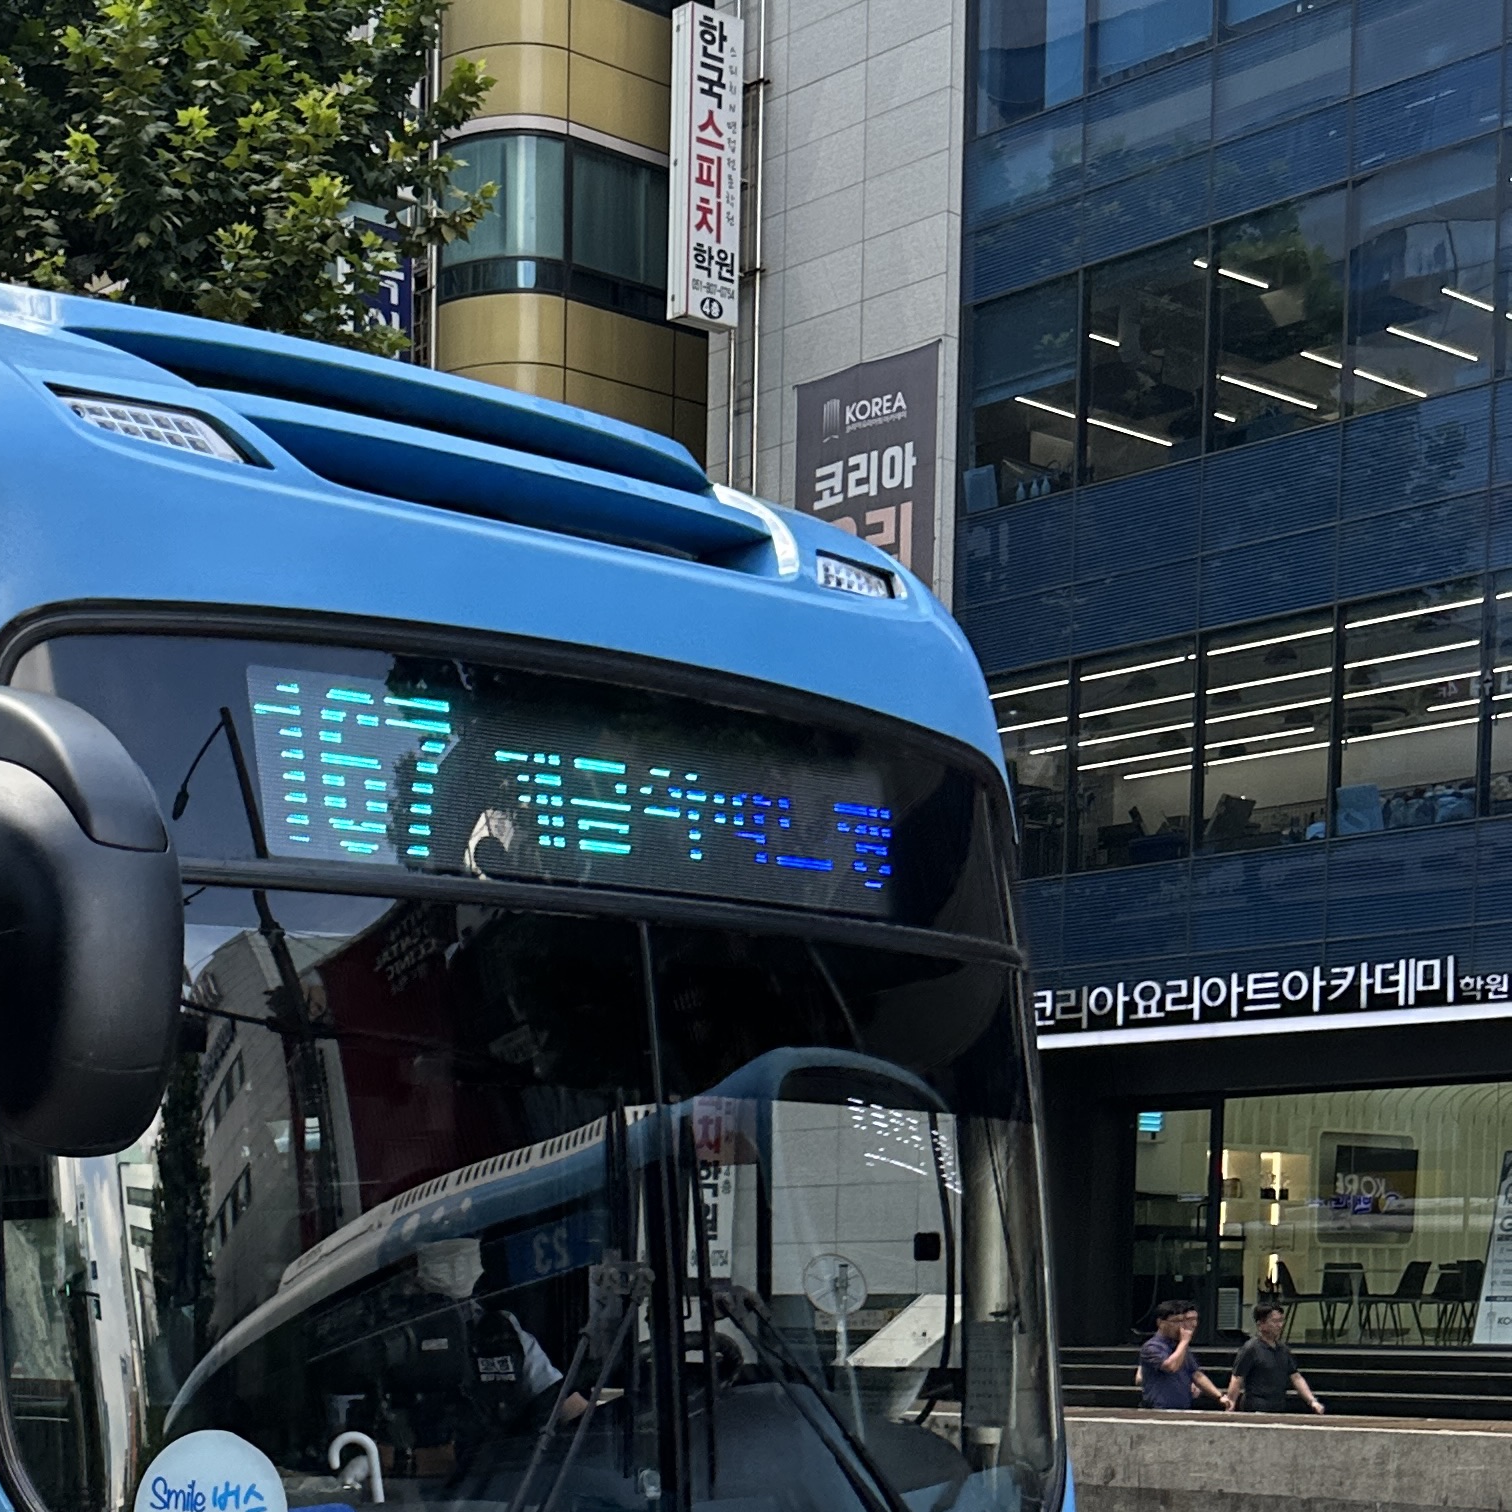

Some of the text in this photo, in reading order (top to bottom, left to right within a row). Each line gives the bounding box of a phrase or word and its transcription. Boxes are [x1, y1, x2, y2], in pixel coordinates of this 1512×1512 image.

[692, 242, 735, 284] 학원
[845, 391, 907, 425] KOREA
[813, 441, 917, 511] 코리아
[828, 501, 913, 574] 리
[253, 683, 451, 857] 167
[1459, 973, 1509, 1000] 학원
[150, 1476, 206, 1512] Smile
